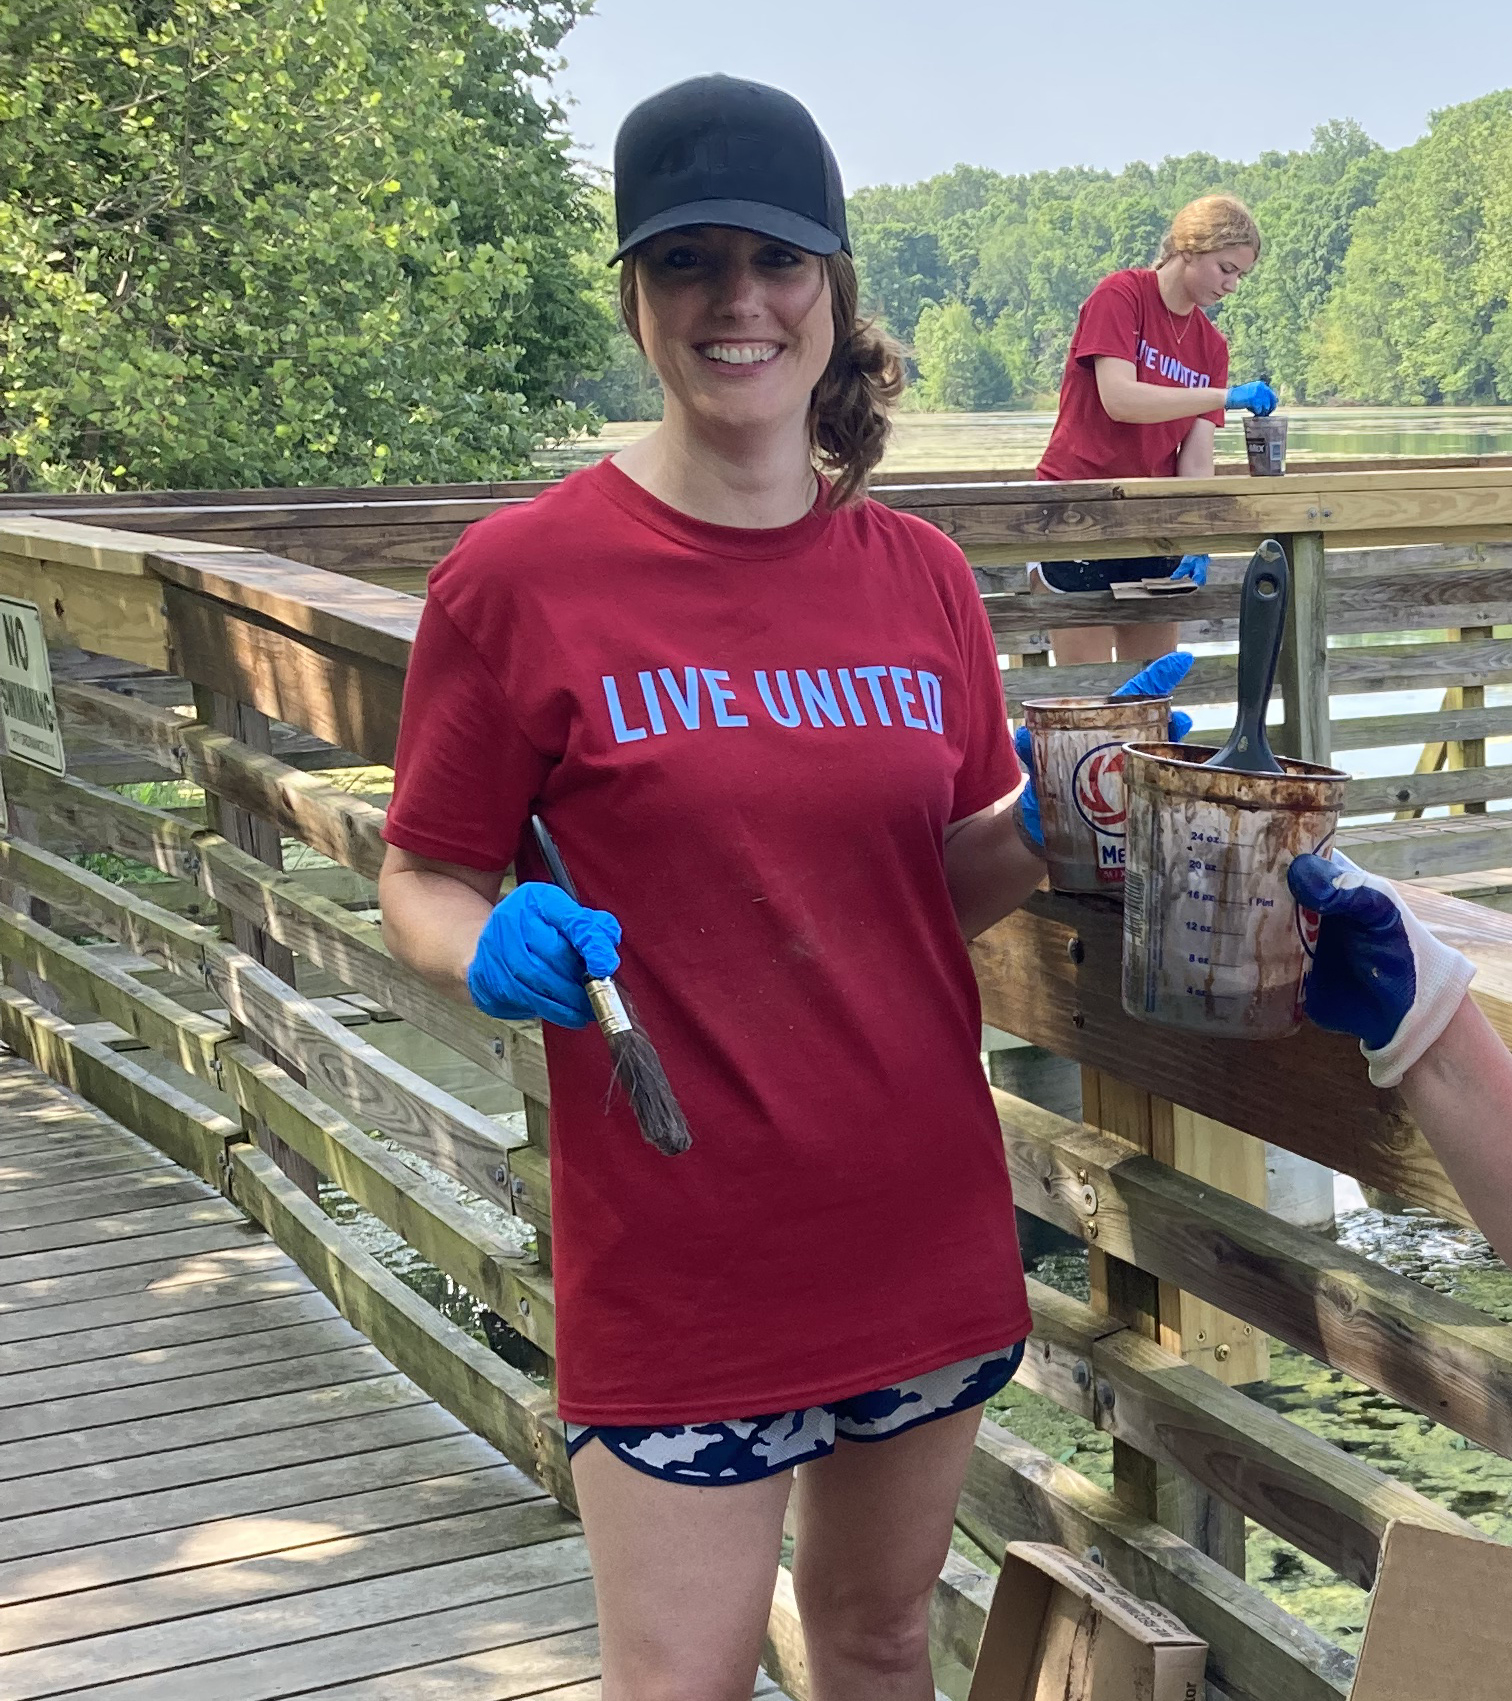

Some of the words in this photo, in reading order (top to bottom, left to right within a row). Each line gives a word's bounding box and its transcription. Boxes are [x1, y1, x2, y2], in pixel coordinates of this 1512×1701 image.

[1160, 354, 1211, 389] UNITED
[1, 612, 29, 672] NO
[602, 666, 749, 743] LIVE
[754, 665, 944, 735] UNITED
[1190, 831, 1204, 842] 24
[1206, 835, 1220, 844] oz
[1189, 860, 1202, 870] 20
[1205, 862, 1217, 872] oz
[1187, 890, 1200, 900] 16
[1202, 893, 1215, 902] oz
[1255, 897, 1274, 908] Pint
[1185, 921, 1198, 931] 12
[1200, 924, 1212, 933] oz
[1188, 954, 1195, 963] 8
[1198, 956, 1209, 964] oz
[1187, 986, 1193, 995] 4
